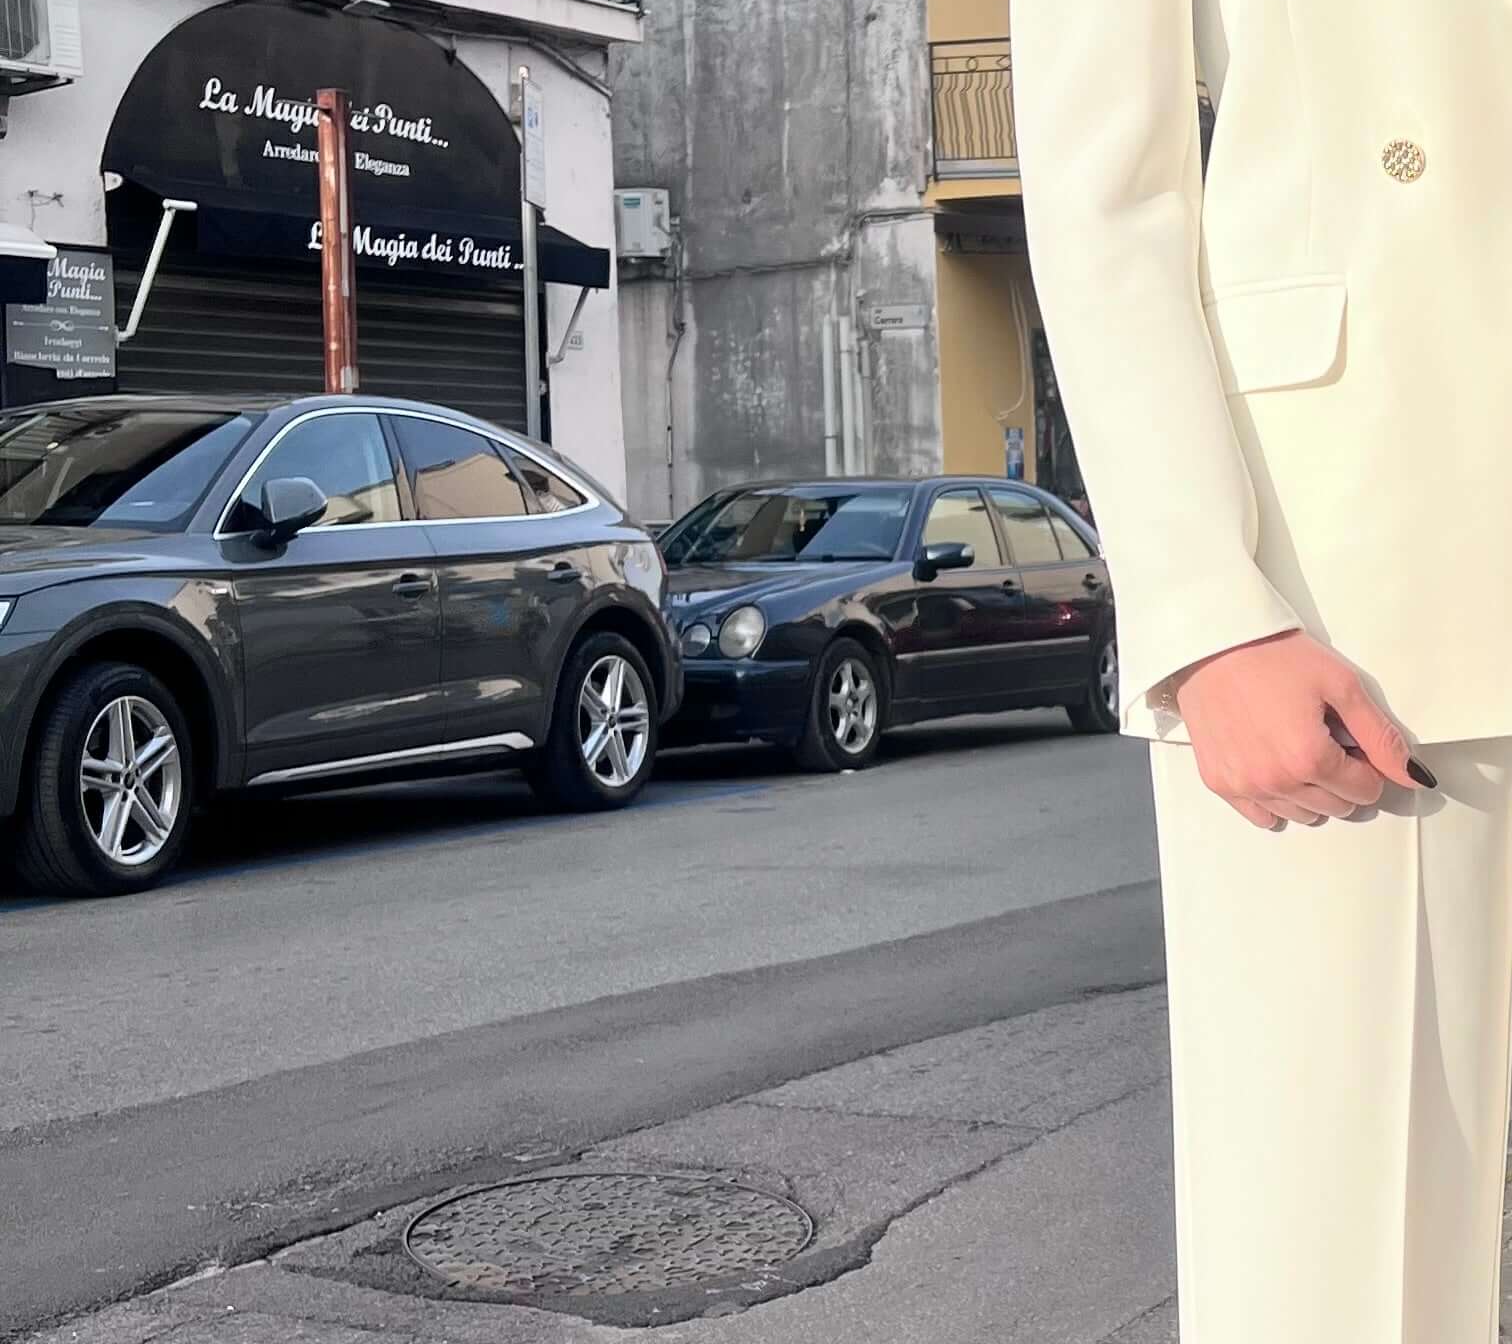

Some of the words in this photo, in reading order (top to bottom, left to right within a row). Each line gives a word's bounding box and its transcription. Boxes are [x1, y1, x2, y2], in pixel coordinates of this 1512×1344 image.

[199, 77, 239, 113] La
[354, 151, 411, 177] Eleganza
[353, 225, 420, 266] Magia
[421, 233, 453, 262] dei
[47, 257, 106, 283] Magia
